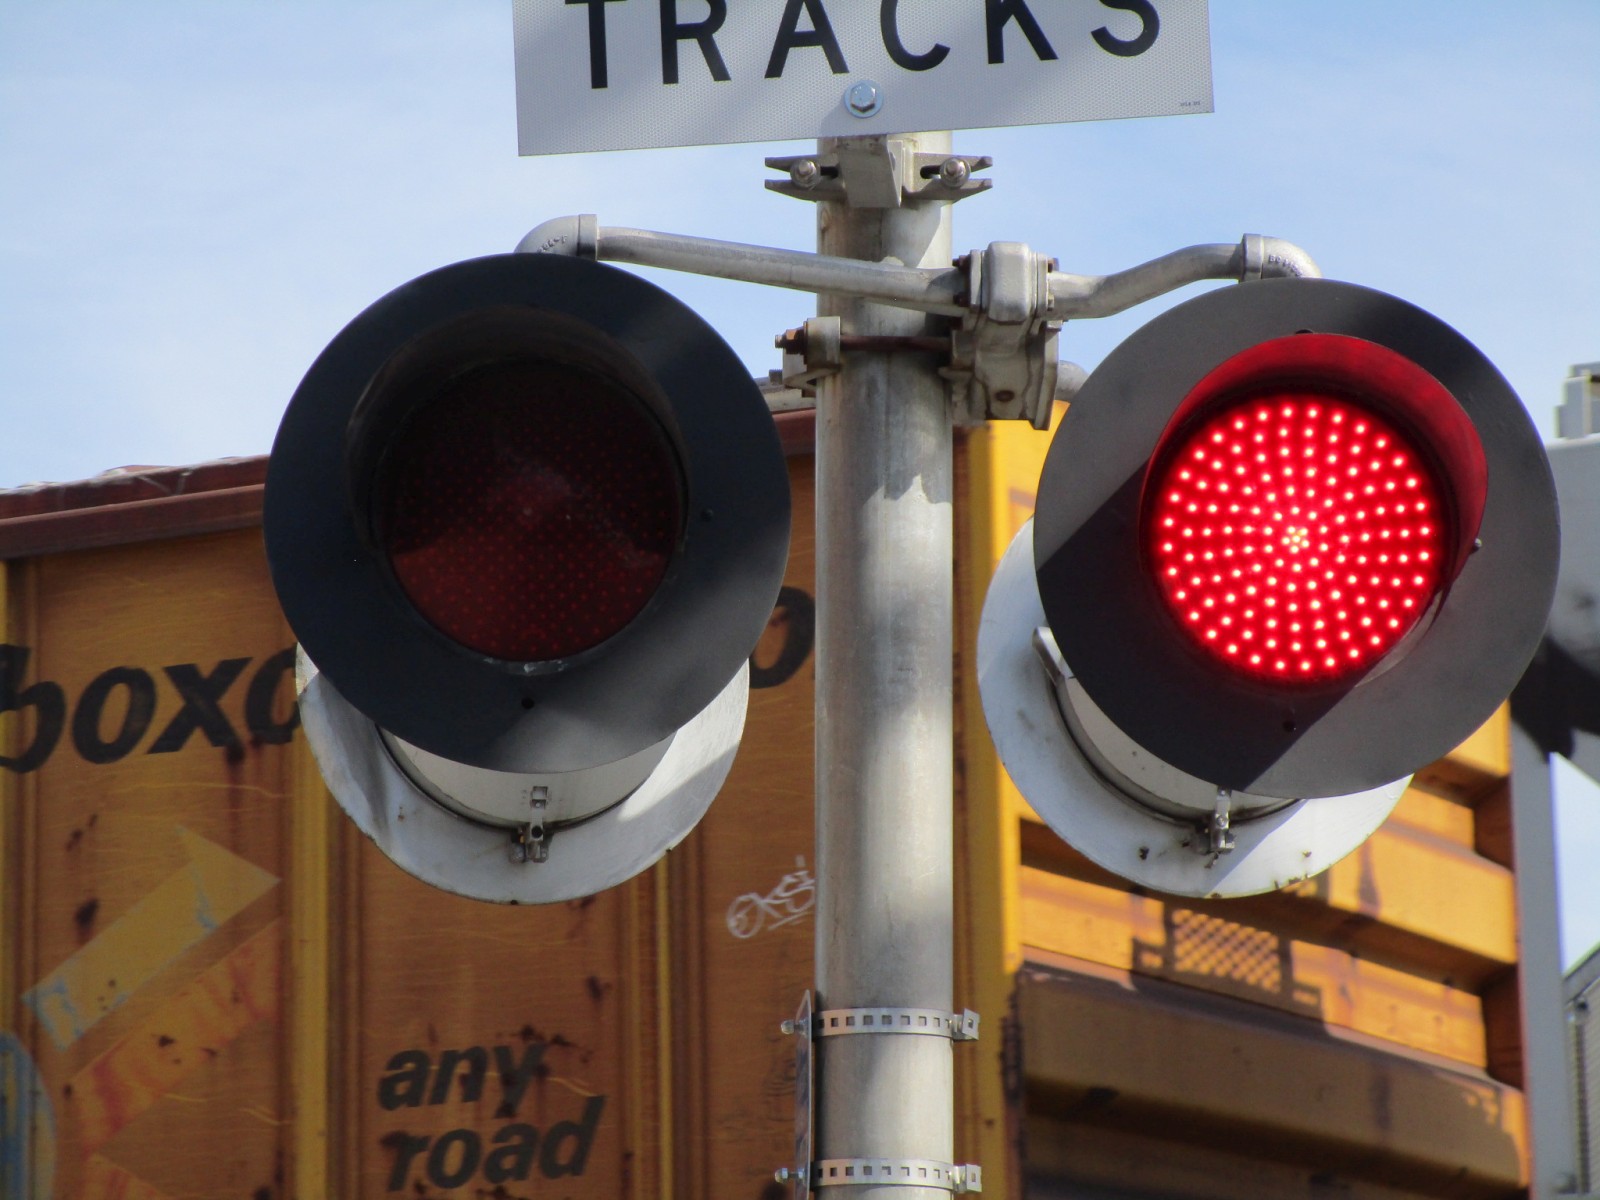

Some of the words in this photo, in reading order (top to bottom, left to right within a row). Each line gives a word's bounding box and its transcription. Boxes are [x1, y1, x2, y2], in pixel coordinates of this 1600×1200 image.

[564, 0, 1160, 89] TRACKS
[377, 1042, 547, 1119] any
[380, 1095, 607, 1192] road
